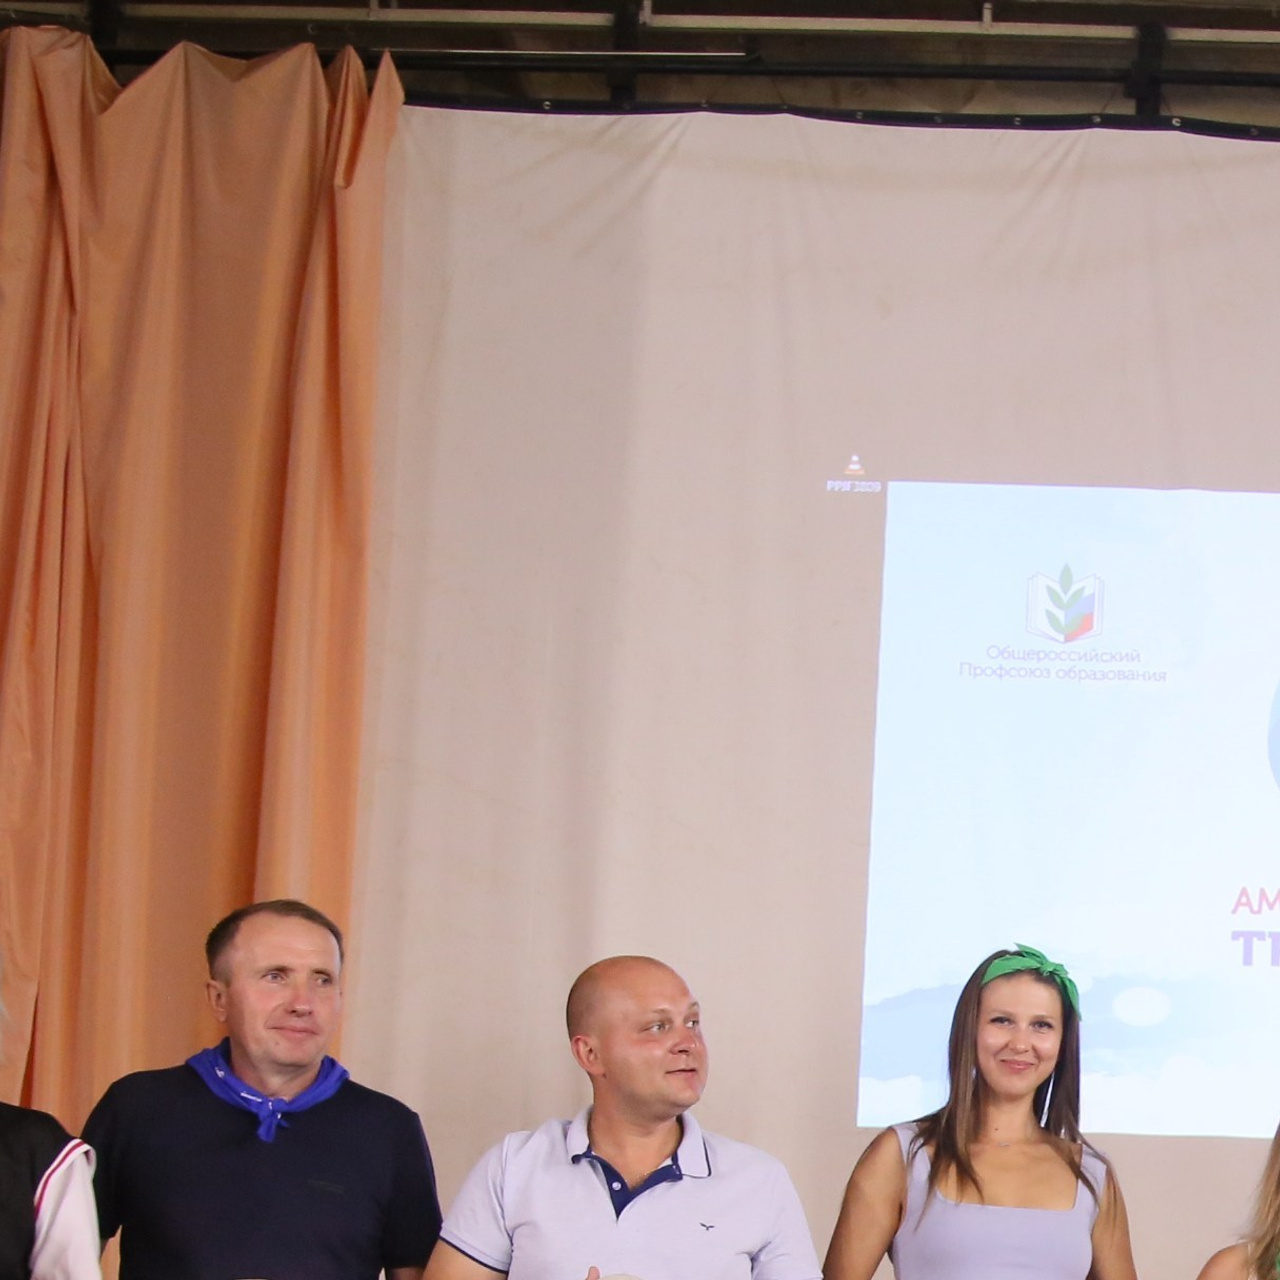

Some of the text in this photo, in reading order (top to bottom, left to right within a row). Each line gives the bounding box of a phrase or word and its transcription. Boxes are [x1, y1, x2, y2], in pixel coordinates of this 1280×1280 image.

[986, 645, 1141, 663] Общероссийский
[959, 662, 1168, 682] Профсоюз образования
